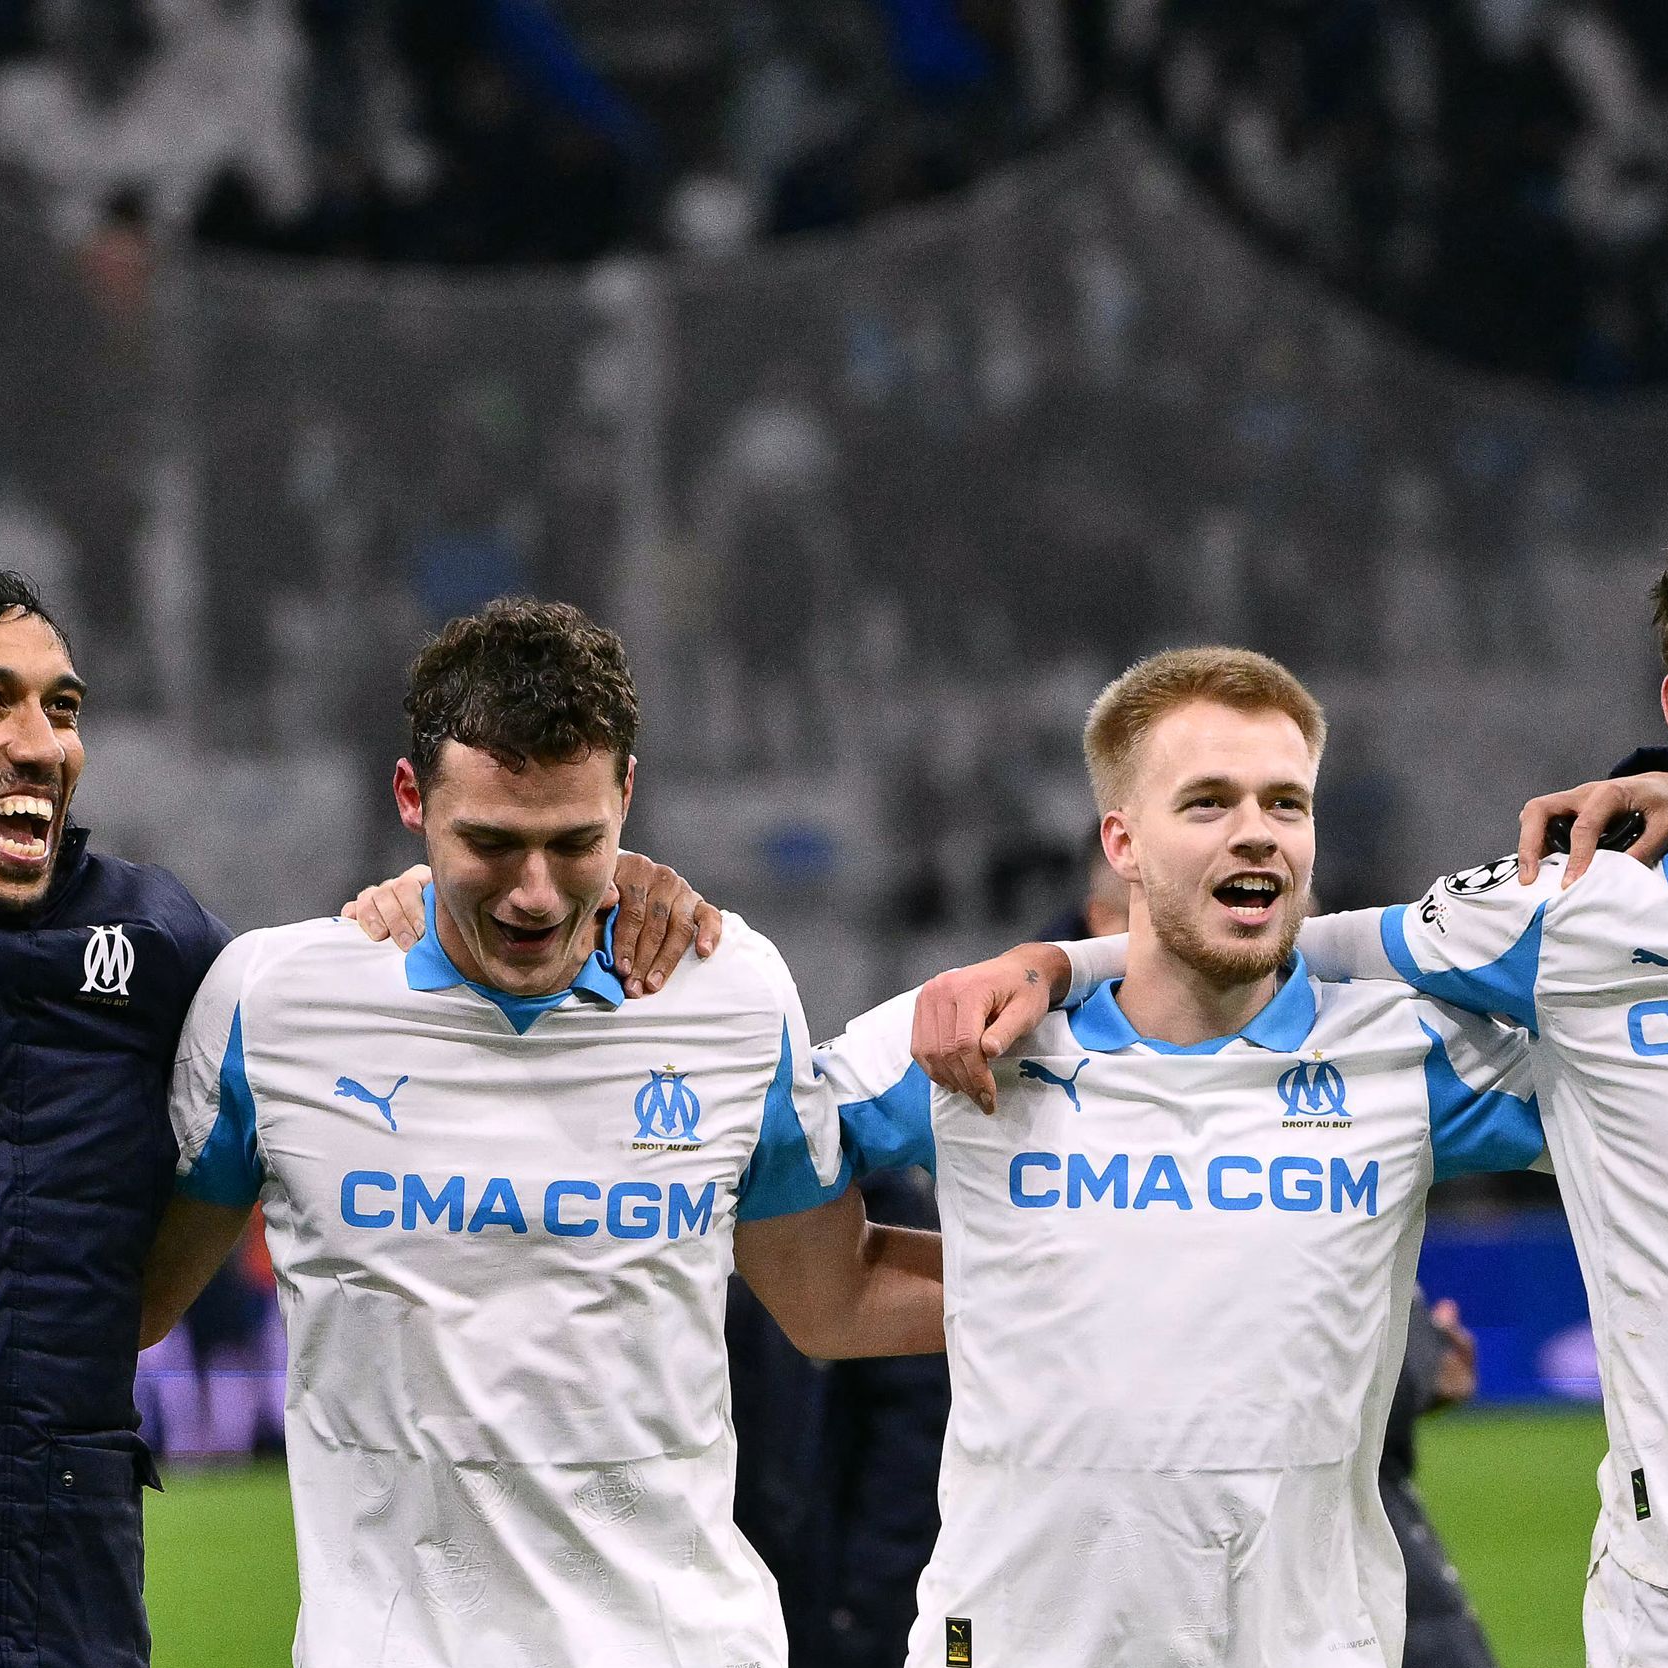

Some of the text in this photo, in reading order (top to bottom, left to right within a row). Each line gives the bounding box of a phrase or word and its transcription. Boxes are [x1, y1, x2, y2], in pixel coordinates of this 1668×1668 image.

[340, 1170, 717, 1240] CMA CGM
[1009, 1151, 1379, 1216] CMA CGM
